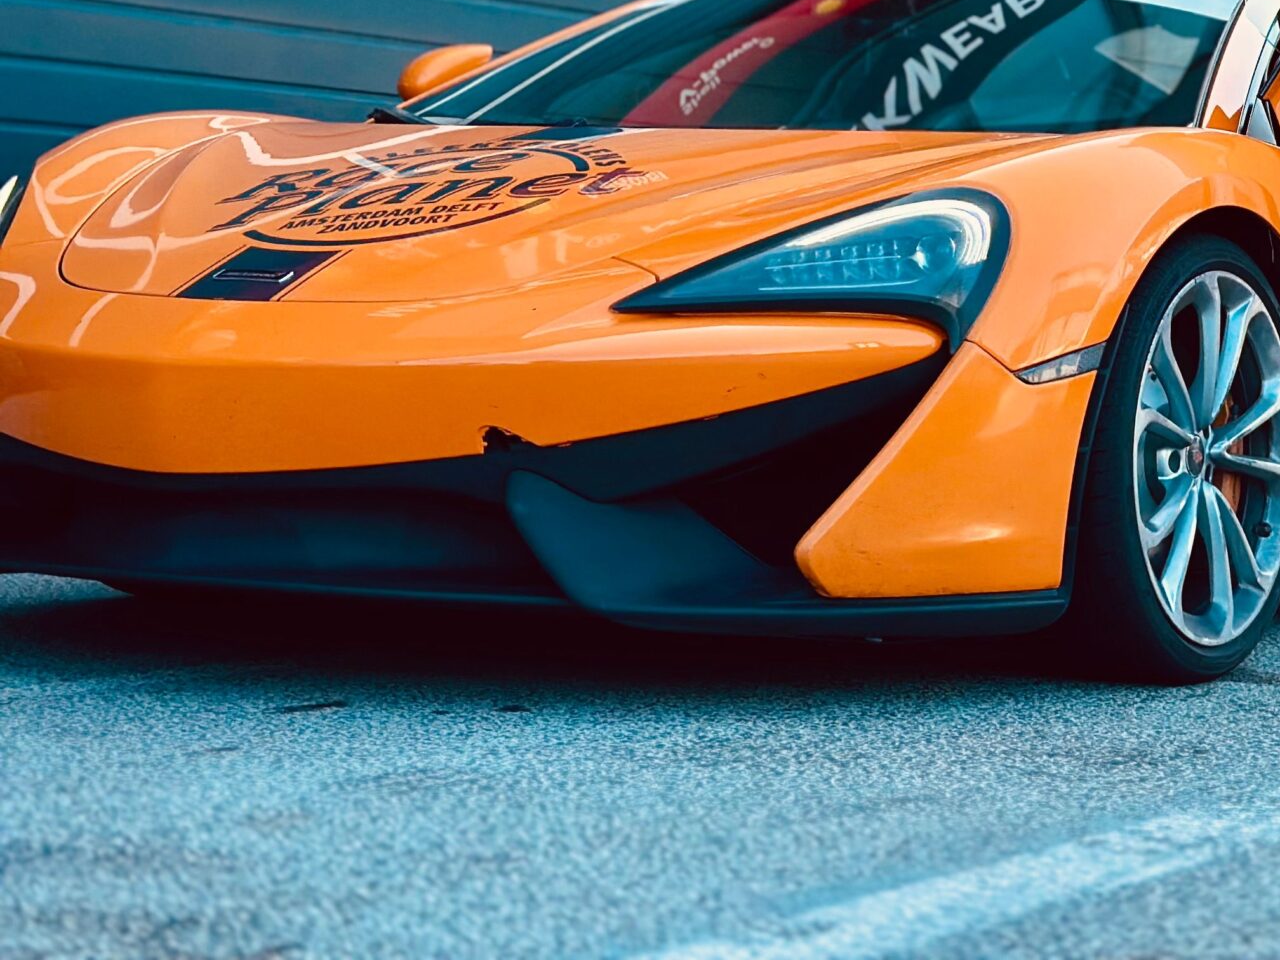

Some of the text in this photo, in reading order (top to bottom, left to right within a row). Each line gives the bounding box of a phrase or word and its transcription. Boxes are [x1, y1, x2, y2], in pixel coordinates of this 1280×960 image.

[213, 149, 533, 206] Race
[277, 201, 504, 231] AMSTERDAM DELFT
[315, 213, 459, 235] ZANDVOORT
